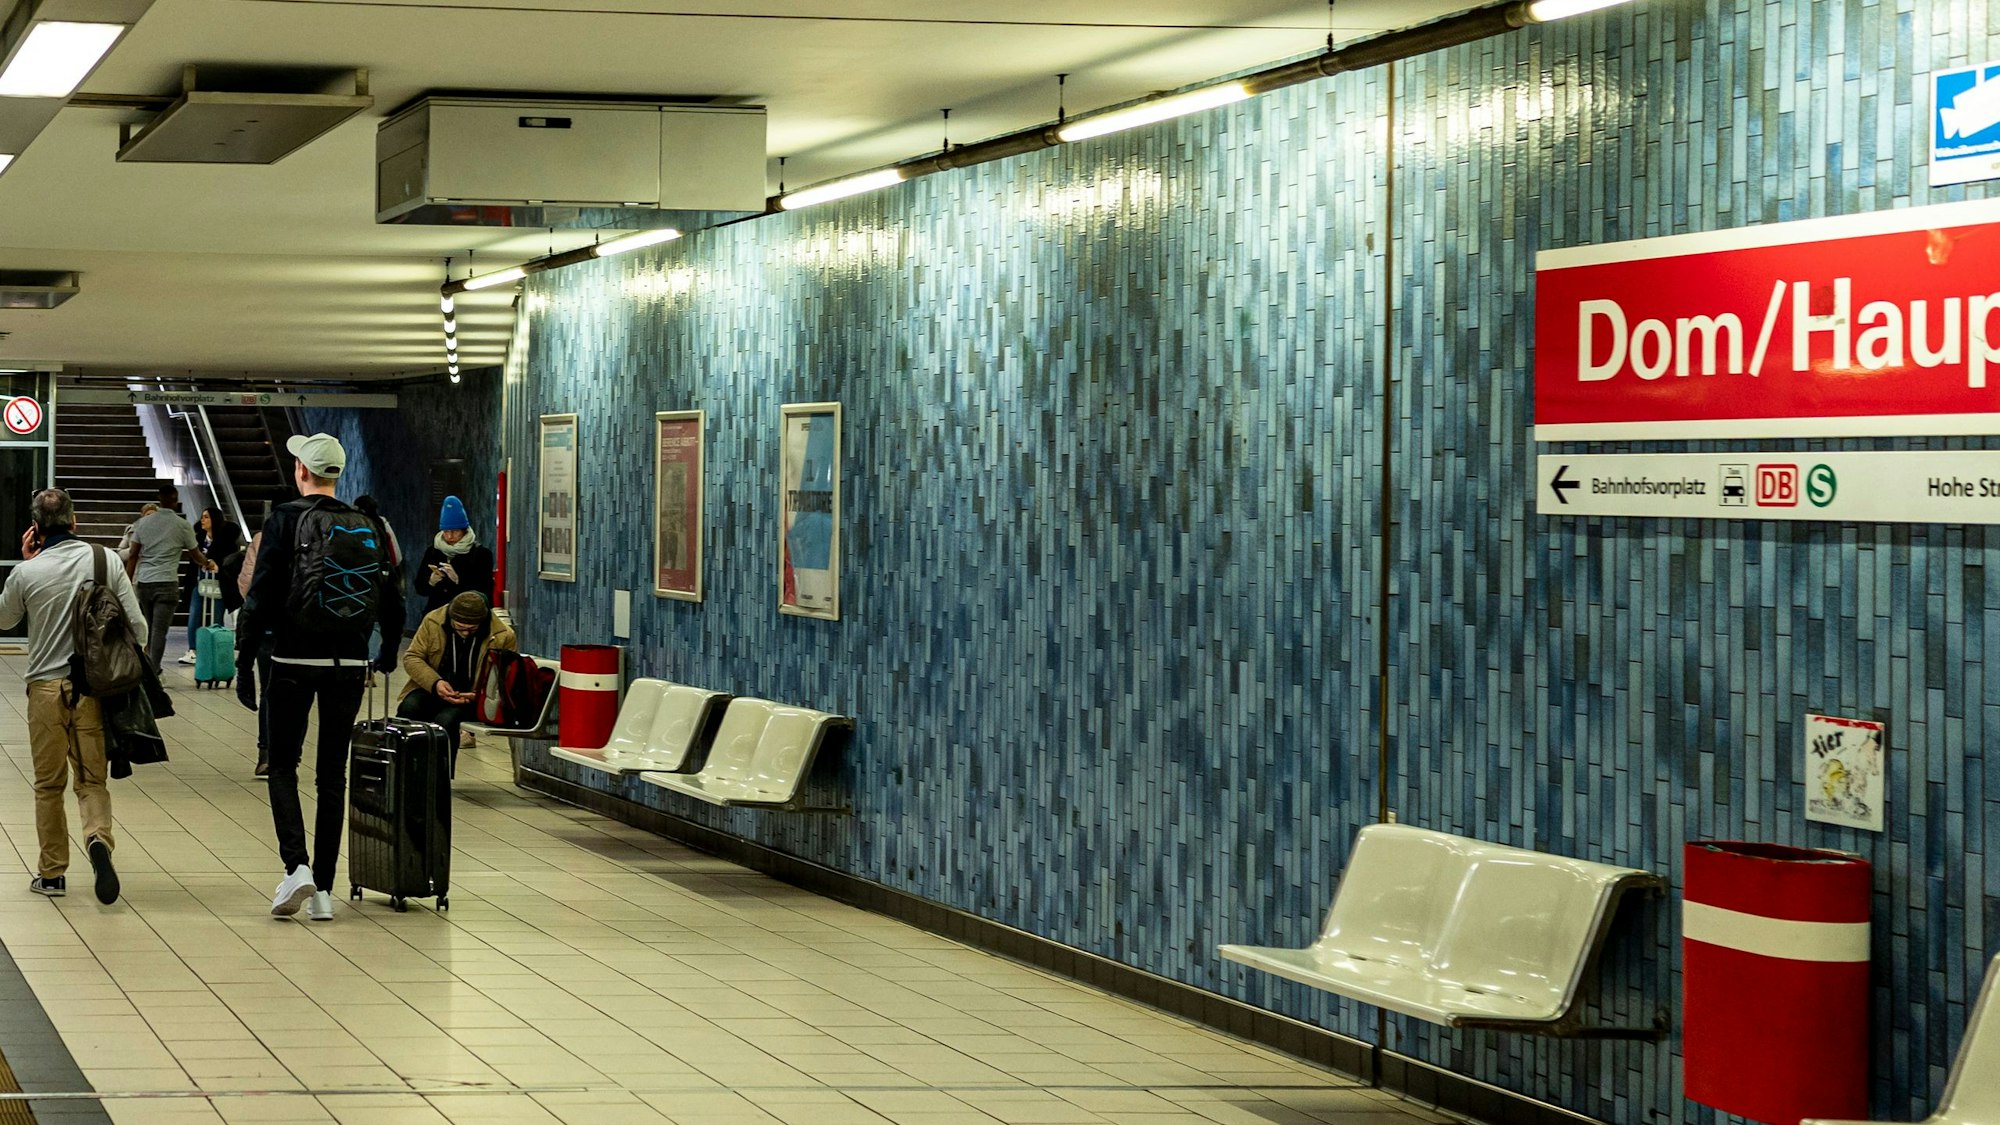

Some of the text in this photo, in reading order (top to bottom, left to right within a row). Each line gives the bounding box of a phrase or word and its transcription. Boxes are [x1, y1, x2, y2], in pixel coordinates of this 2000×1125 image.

[1578, 277, 2000, 388] Dom/Haup
[1592, 467, 1834, 504] Bahnhofsvorplatz DB S
[1928, 476, 1974, 497] Hohe
